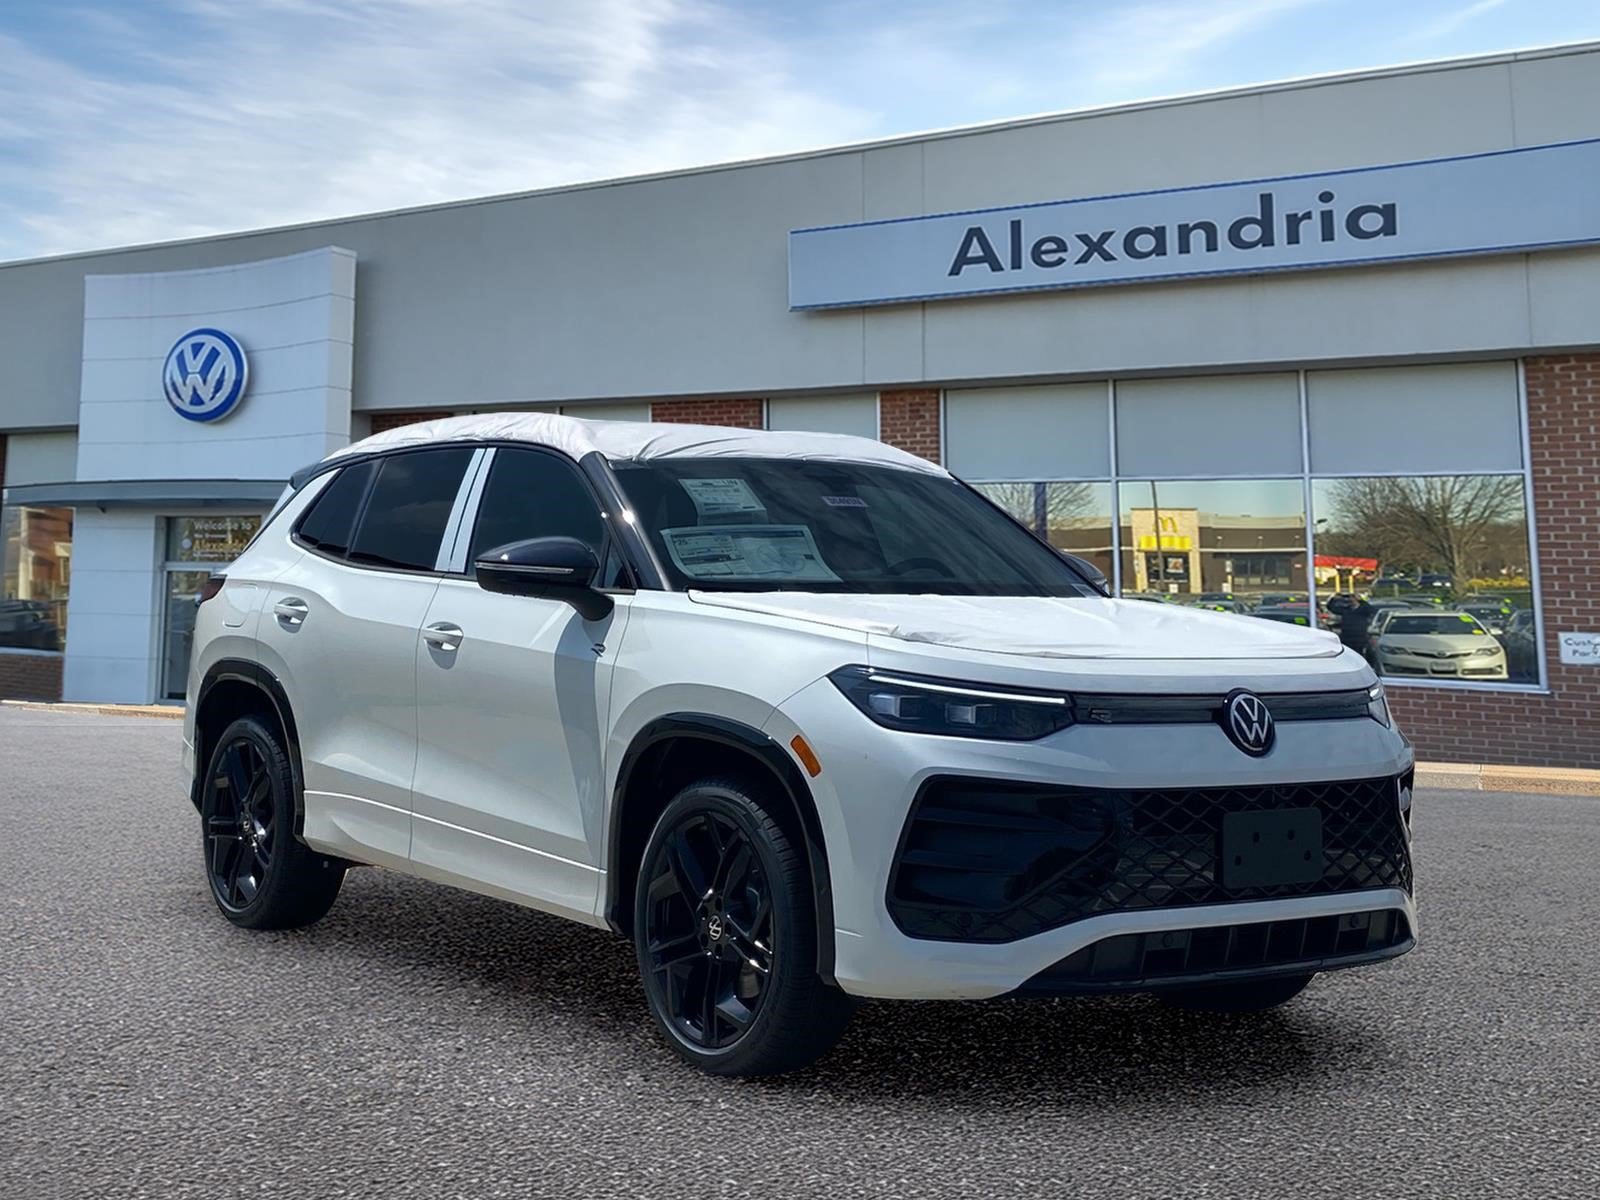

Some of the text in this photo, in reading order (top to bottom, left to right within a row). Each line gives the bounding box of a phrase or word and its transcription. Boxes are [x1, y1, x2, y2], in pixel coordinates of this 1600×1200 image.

[947, 190, 1398, 277] Alexandria
[164, 331, 241, 416] VW
[1231, 693, 1271, 751] VW
